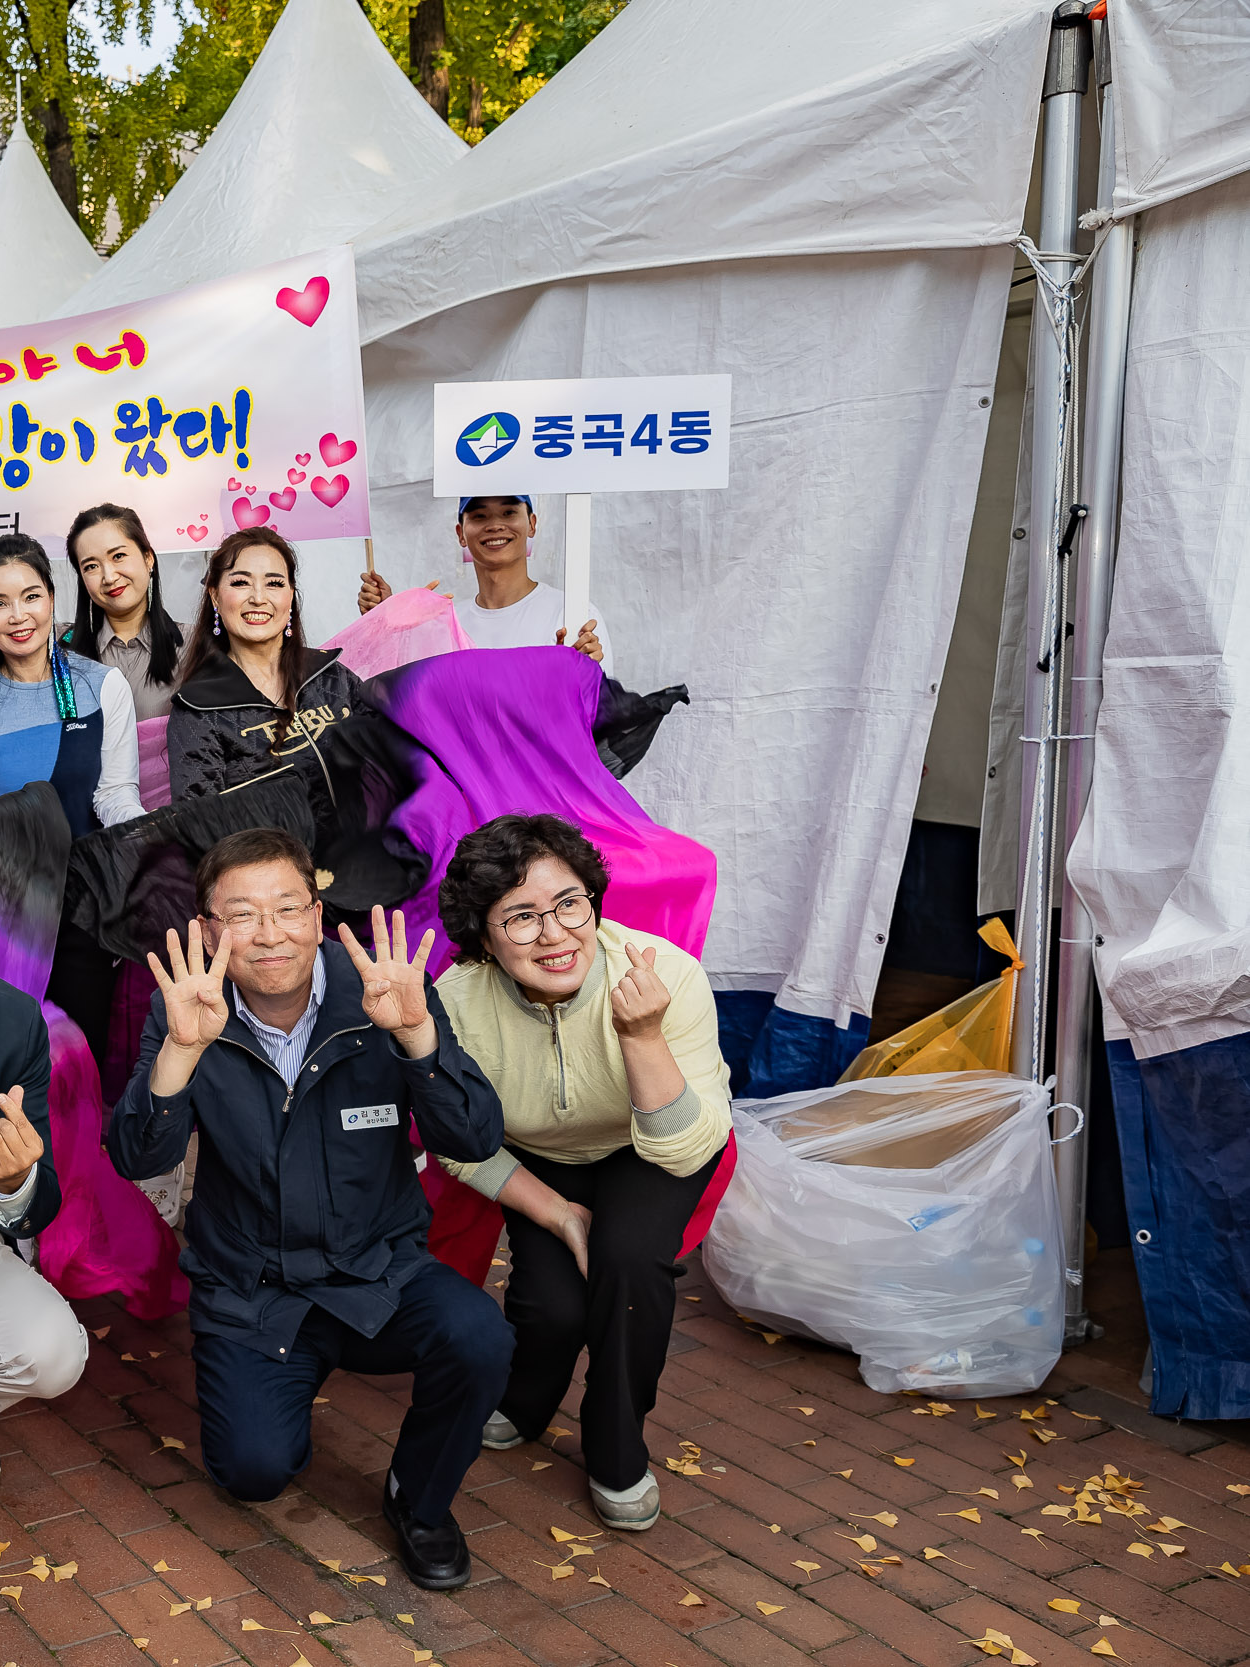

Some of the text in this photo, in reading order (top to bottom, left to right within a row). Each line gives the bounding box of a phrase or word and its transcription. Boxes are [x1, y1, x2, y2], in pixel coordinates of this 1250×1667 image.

[74, 329, 148, 375] 너
[113, 386, 253, 478] 왔다!
[532, 410, 712, 459] 중곡4동
